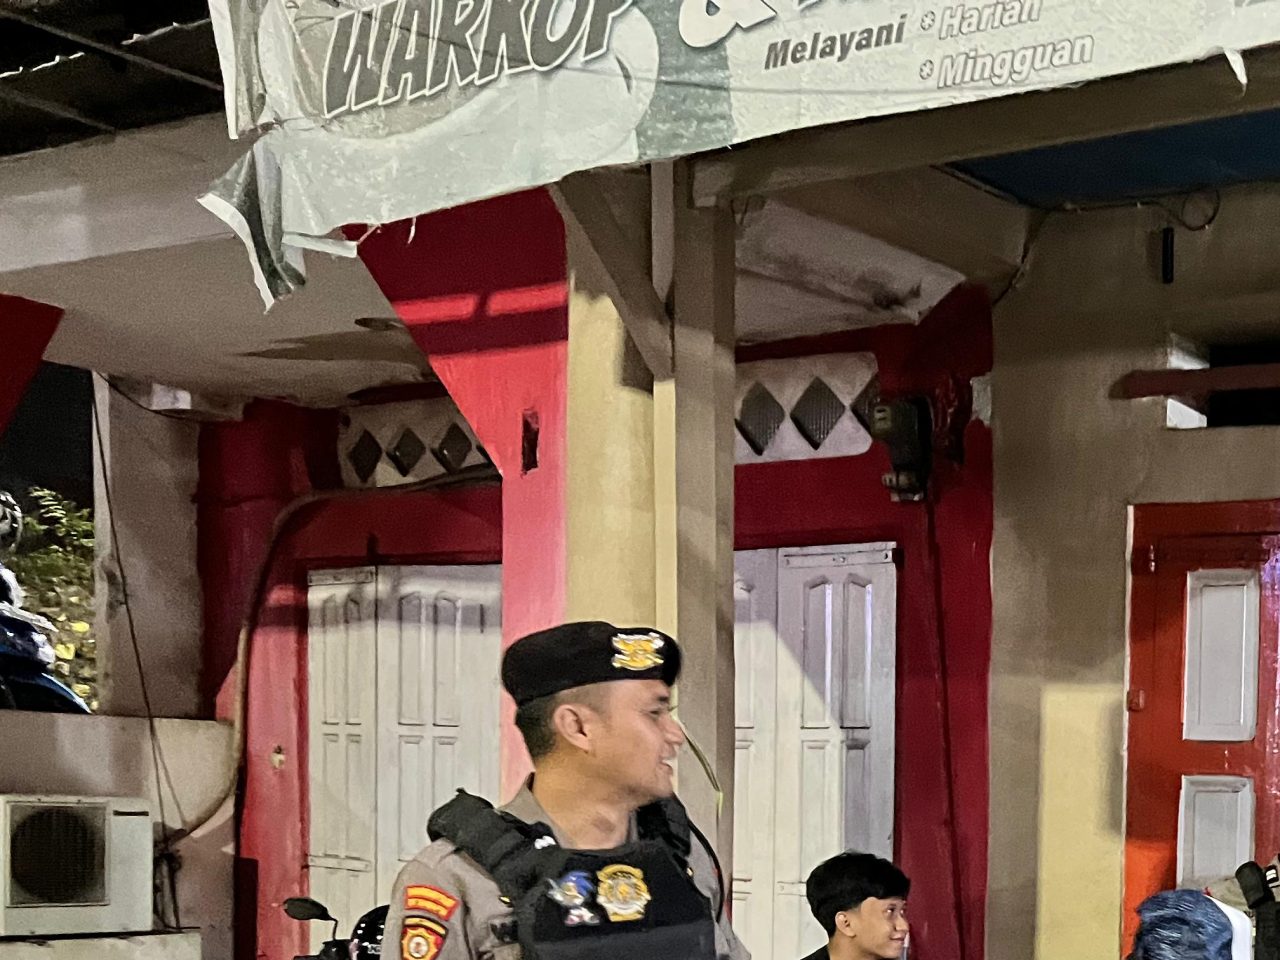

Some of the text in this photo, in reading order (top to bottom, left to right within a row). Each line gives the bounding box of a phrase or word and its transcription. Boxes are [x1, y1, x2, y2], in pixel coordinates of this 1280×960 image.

[764, 0, 1043, 71] Melayani Harian
[936, 34, 1095, 90] Mingguan
